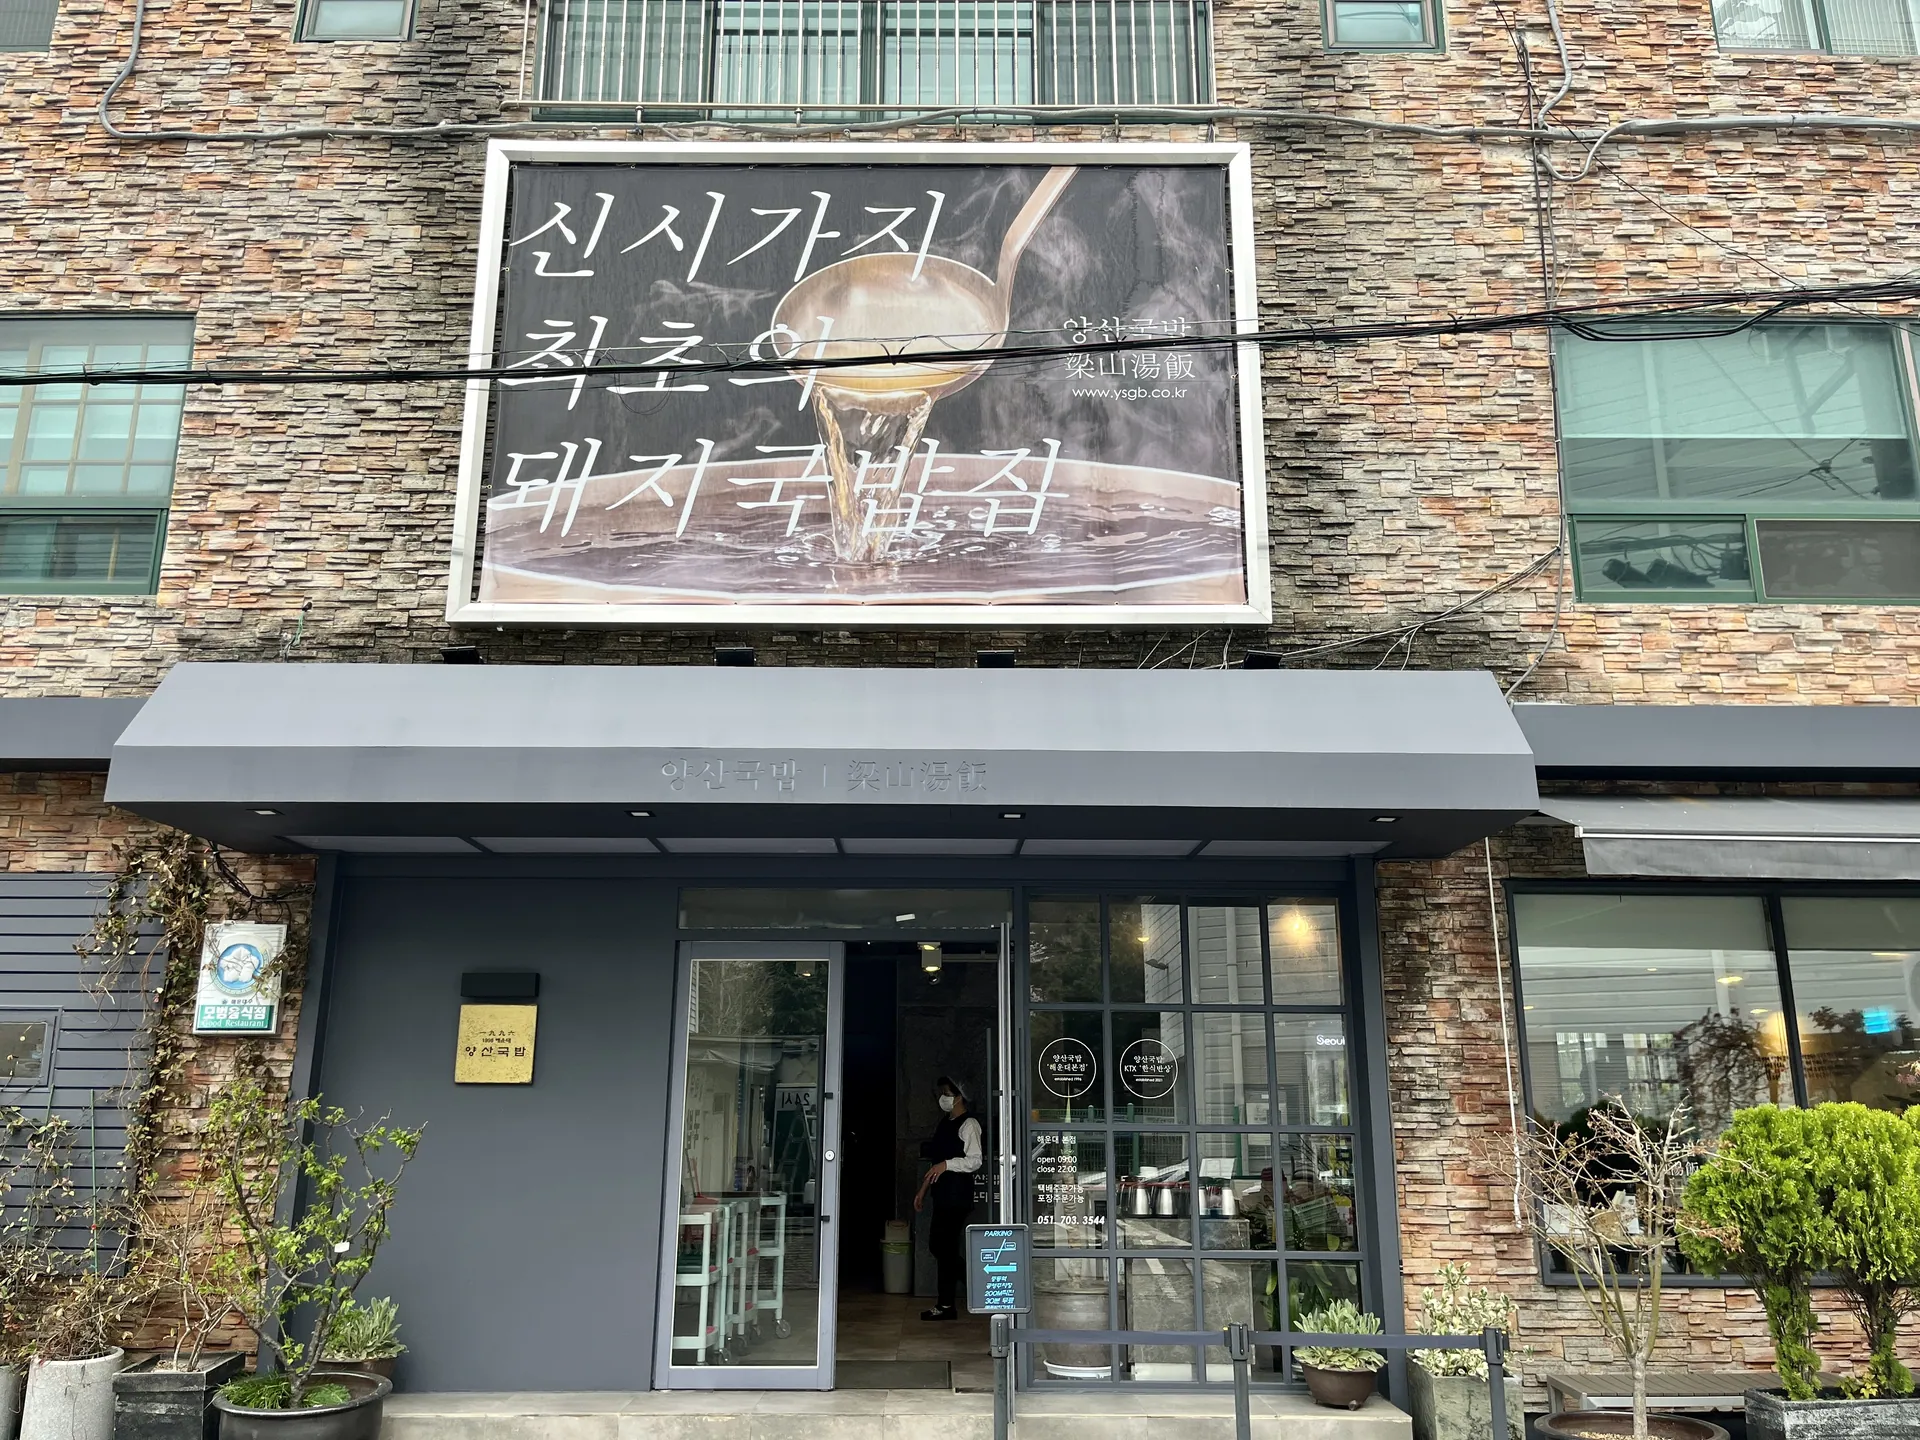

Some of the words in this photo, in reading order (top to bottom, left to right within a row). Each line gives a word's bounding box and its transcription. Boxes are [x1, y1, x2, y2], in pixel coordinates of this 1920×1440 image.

[510, 190, 946, 282] 신시가지
[497, 315, 836, 412] 최초의
[1064, 352, 1196, 379] 梁山湯飯
[1072, 387, 1187, 400] www.ysgb.co.kr
[489, 437, 1070, 538] 돼지국밥집
[661, 757, 802, 792] 양산국밥
[847, 759, 988, 793] 梁山湯飯
[203, 1006, 266, 1019] 모범음식점
[202, 1019, 222, 1027] Good
[225, 1019, 264, 1027] Restaurant
[1316, 1034, 1346, 1046] Seoul
[465, 1046, 527, 1057] 양산국밥
[1052, 1054, 1082, 1063] 양산국밥
[1133, 1055, 1165, 1064] 양산국밥
[1124, 1064, 1137, 1073] KTX
[1037, 1135, 1060, 1145] 해운대
[1062, 1135, 1077, 1145] 본점
[1037, 1156, 1056, 1165] open
[1057, 1155, 1078, 1164] 09:00
[1037, 1165, 1056, 1173] close
[1057, 1165, 1078, 1173] 22:00
[1037, 1184, 1085, 1194] 택배주문가능
[1037, 1194, 1085, 1204] 포장주문가능
[1060, 1215, 1080, 1225] 703.
[1082, 1215, 1106, 1225] 3544
